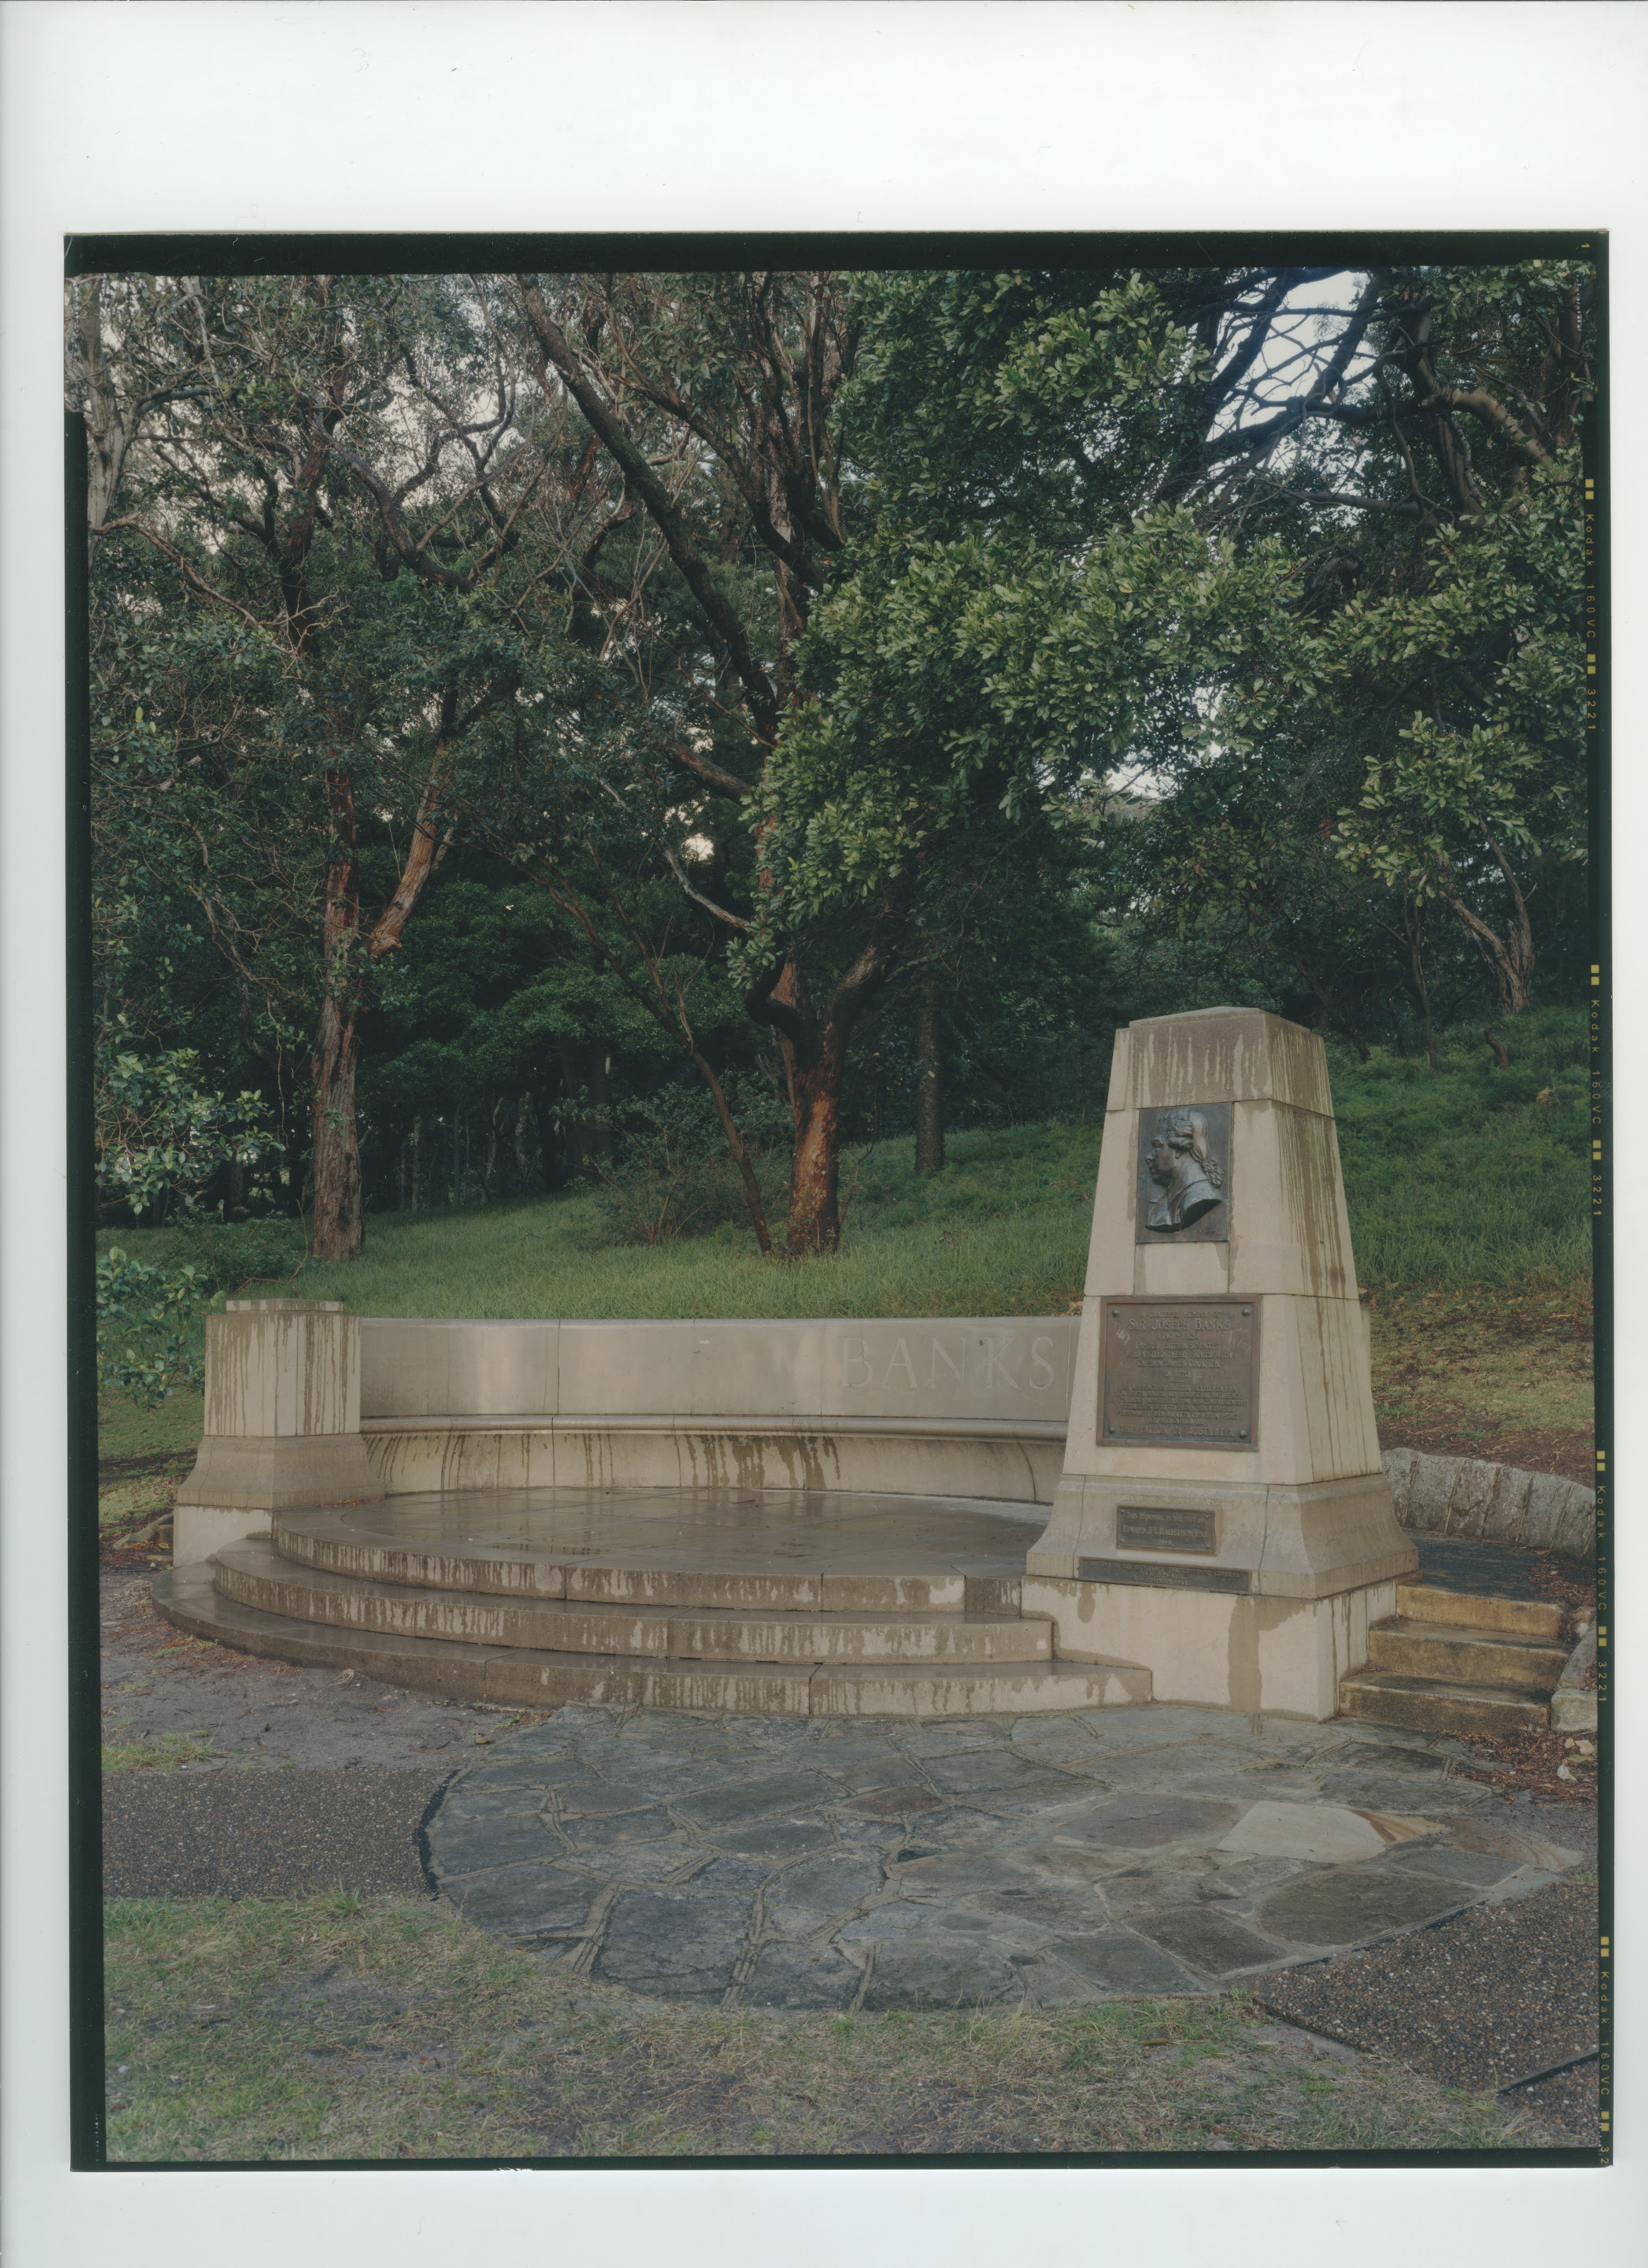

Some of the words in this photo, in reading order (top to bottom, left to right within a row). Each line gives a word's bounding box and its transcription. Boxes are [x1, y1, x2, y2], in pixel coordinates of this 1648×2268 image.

[1586, 514, 1594, 566] Kodak
[1587, 585, 1596, 638] 160VC
[1587, 690, 1596, 729] 3221
[1592, 1070, 1600, 1124] 160VC
[1593, 1176, 1602, 1215] 3221
[1129, 1319, 1146, 1330] SIR
[1151, 1319, 1189, 1330] JOSEPH
[1195, 1318, 1230, 1330] BANKS
[839, 1336, 1054, 1391] BANKS
[1120, 1425, 1134, 1433] THE
[1140, 1425, 1167, 1434] PATRON
[1175, 1426, 1183, 1434] OF
[1123, 1525, 1146, 1534] EDWARD
[1597, 1486, 1605, 1537] Kodak
[1135, 1564, 1164, 1572] EXCELLENCY
[1598, 1557, 1606, 1610] 160VC
[1598, 1662, 1607, 1701] 3221
[1601, 2042, 1609, 2095] 160VC
